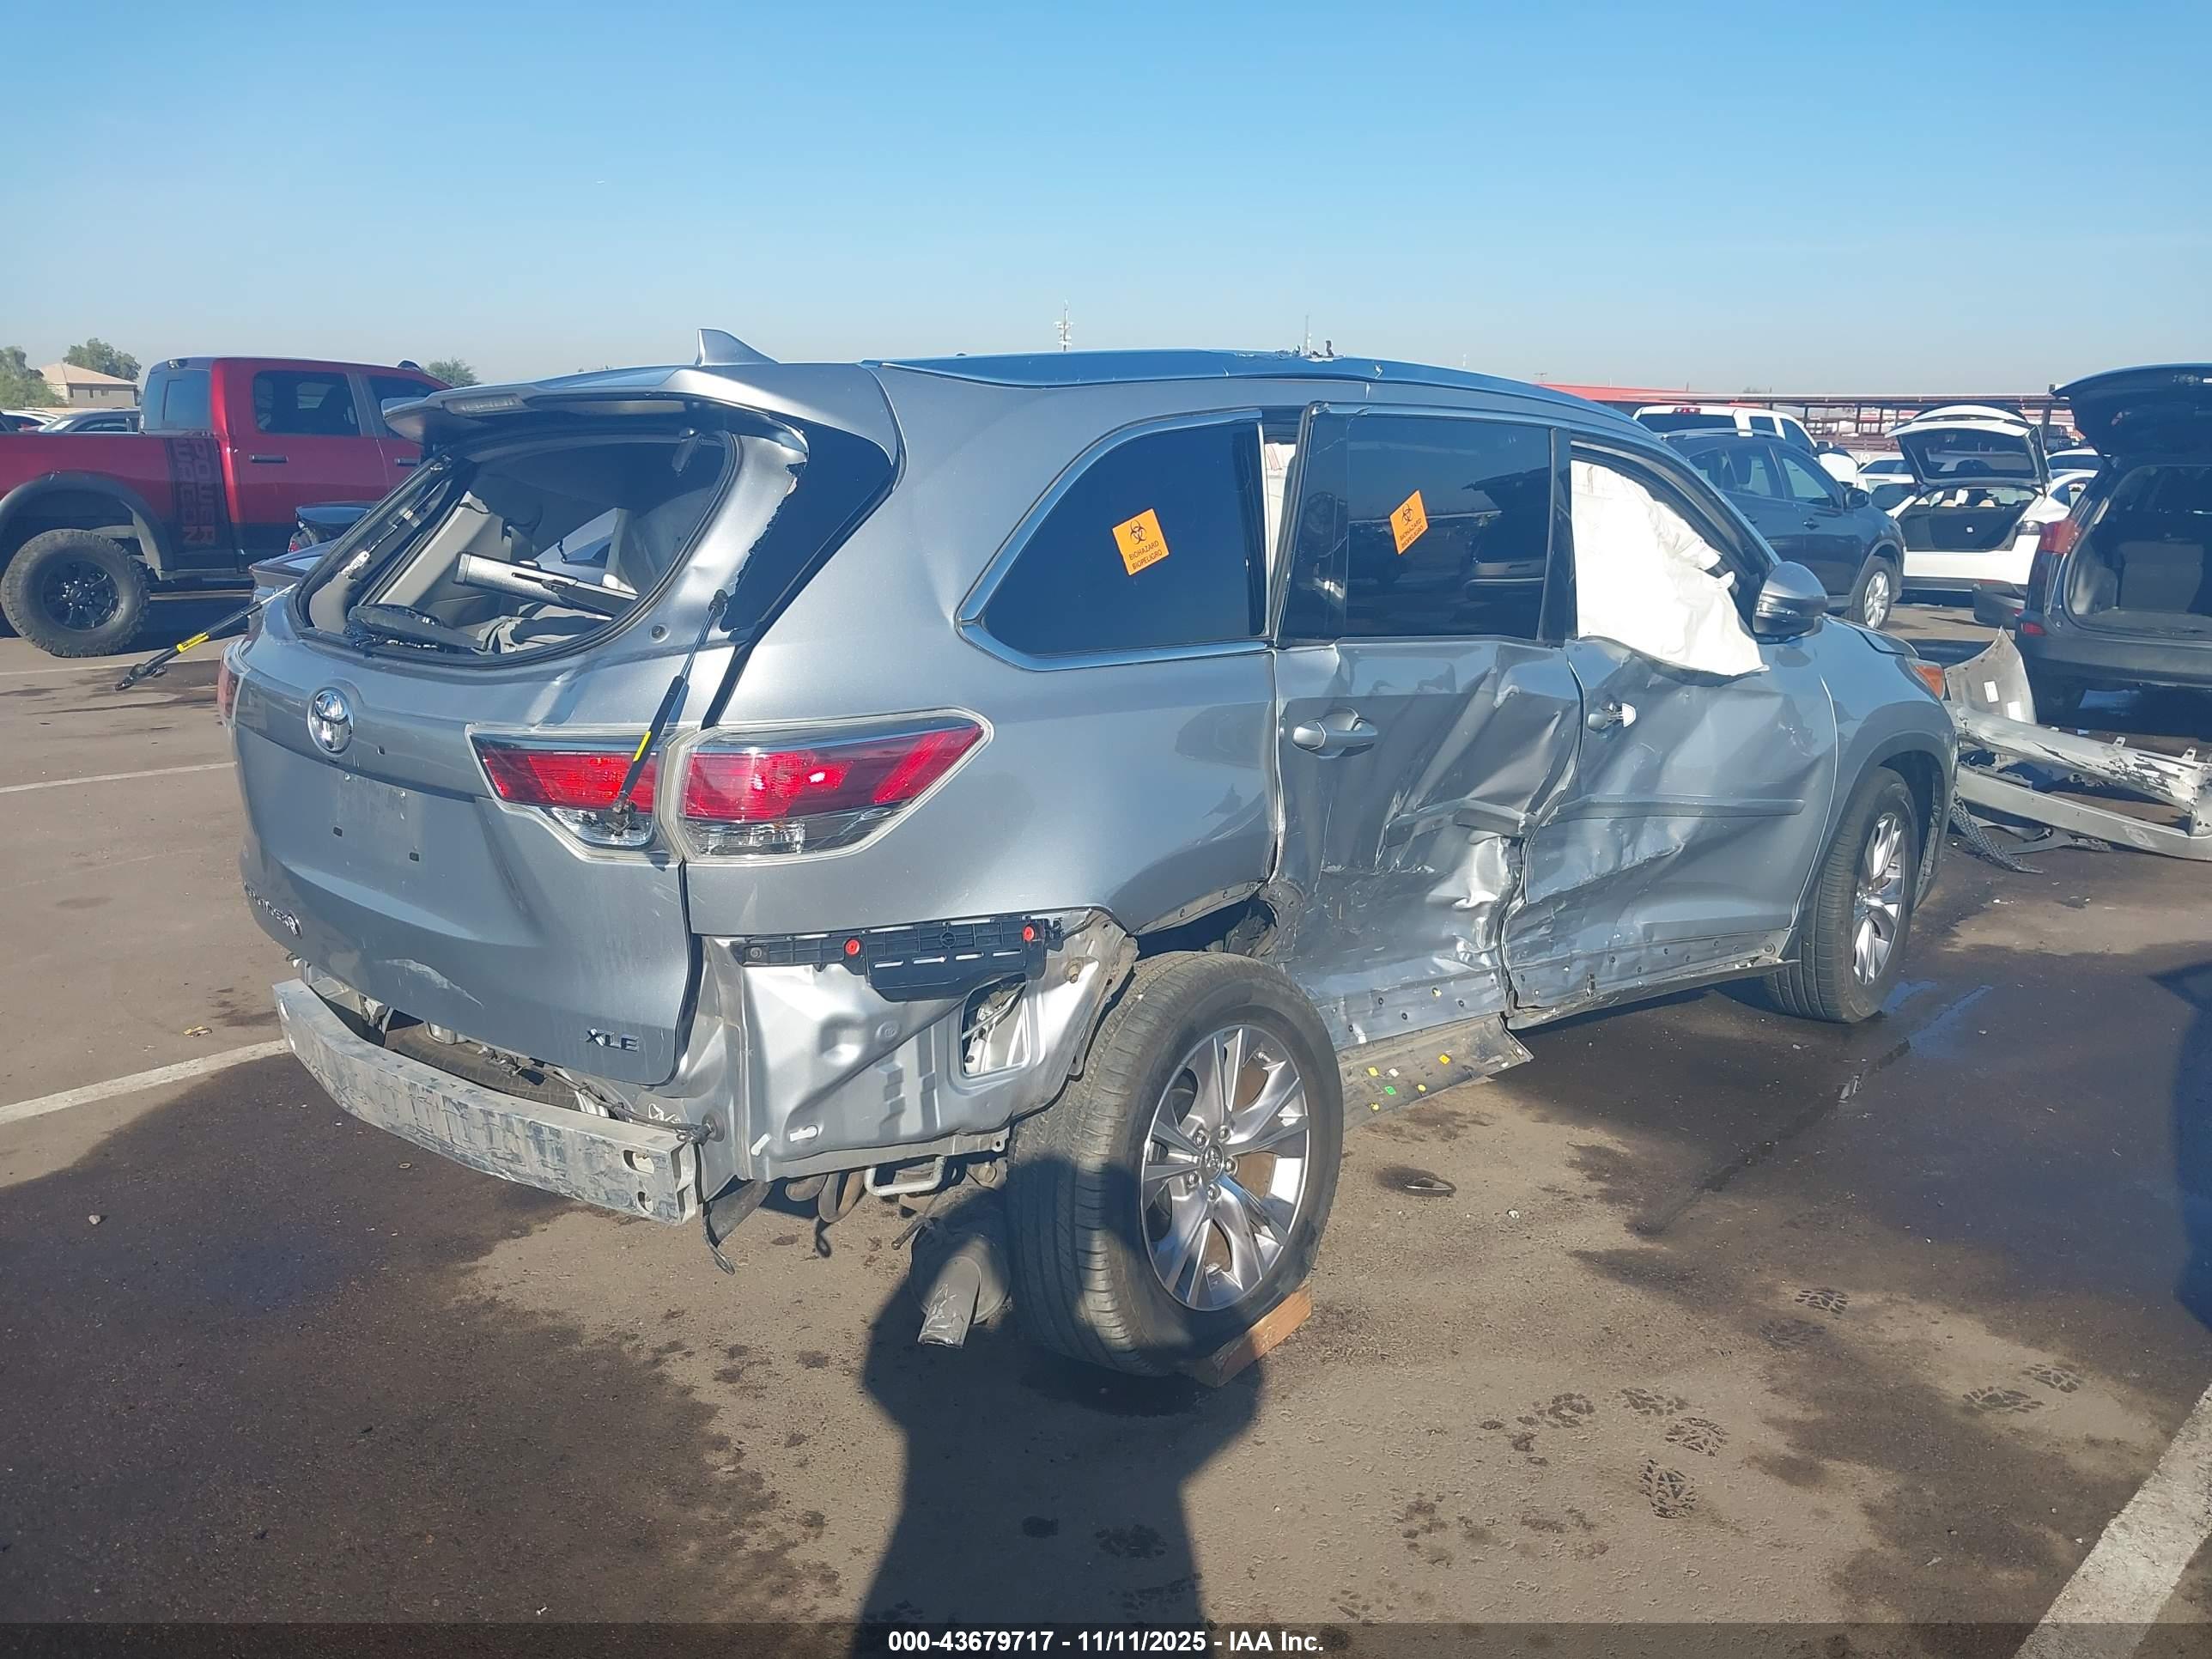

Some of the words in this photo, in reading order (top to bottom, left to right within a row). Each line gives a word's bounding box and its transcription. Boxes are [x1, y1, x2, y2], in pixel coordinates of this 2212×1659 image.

[194, 441, 216, 544] POWER
[1128, 540, 1159, 561] BIOHAZARD
[1132, 549, 1163, 570] BIOPELIGRO
[585, 1026, 639, 1052] XLE
